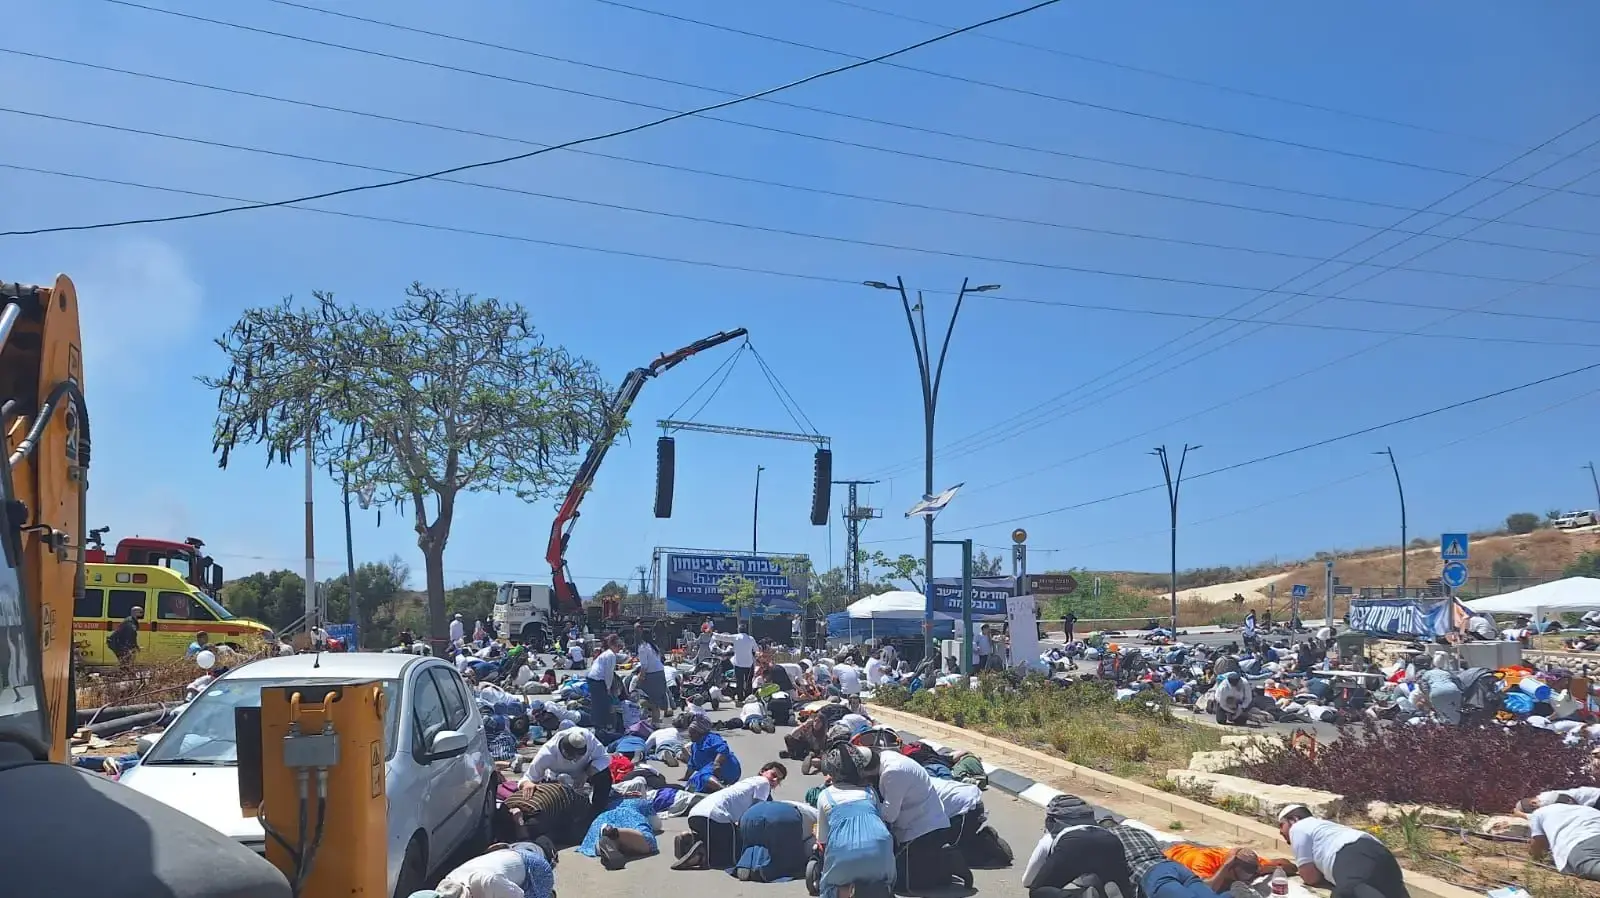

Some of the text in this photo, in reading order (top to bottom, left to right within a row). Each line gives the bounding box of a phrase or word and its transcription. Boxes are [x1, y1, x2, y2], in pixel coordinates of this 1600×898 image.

[672, 557, 714, 573] ביטחון
[936, 587, 1009, 600] חוזרים לתיישב
[948, 599, 964, 608] זה
